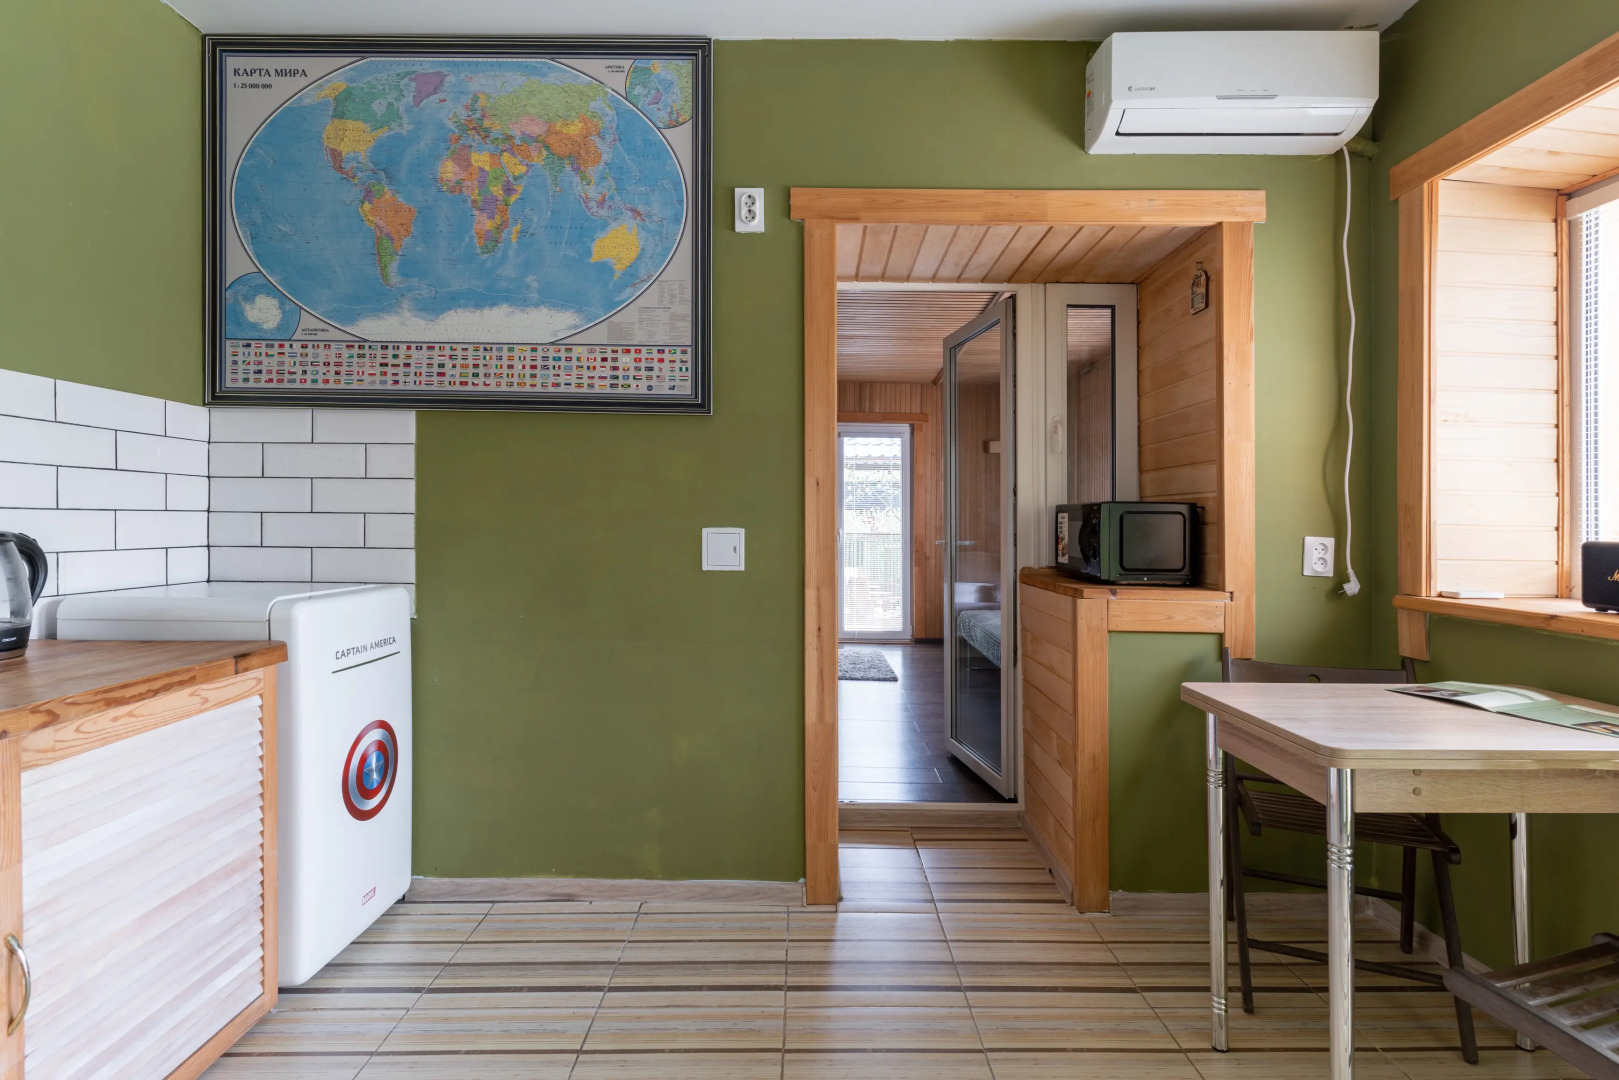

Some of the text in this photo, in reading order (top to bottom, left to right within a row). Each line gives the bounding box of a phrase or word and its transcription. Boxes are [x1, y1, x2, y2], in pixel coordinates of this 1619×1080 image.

[233, 68, 308, 78] КАРТА МИРА
[336, 636, 396, 660] CAPTAIN AMERICA
